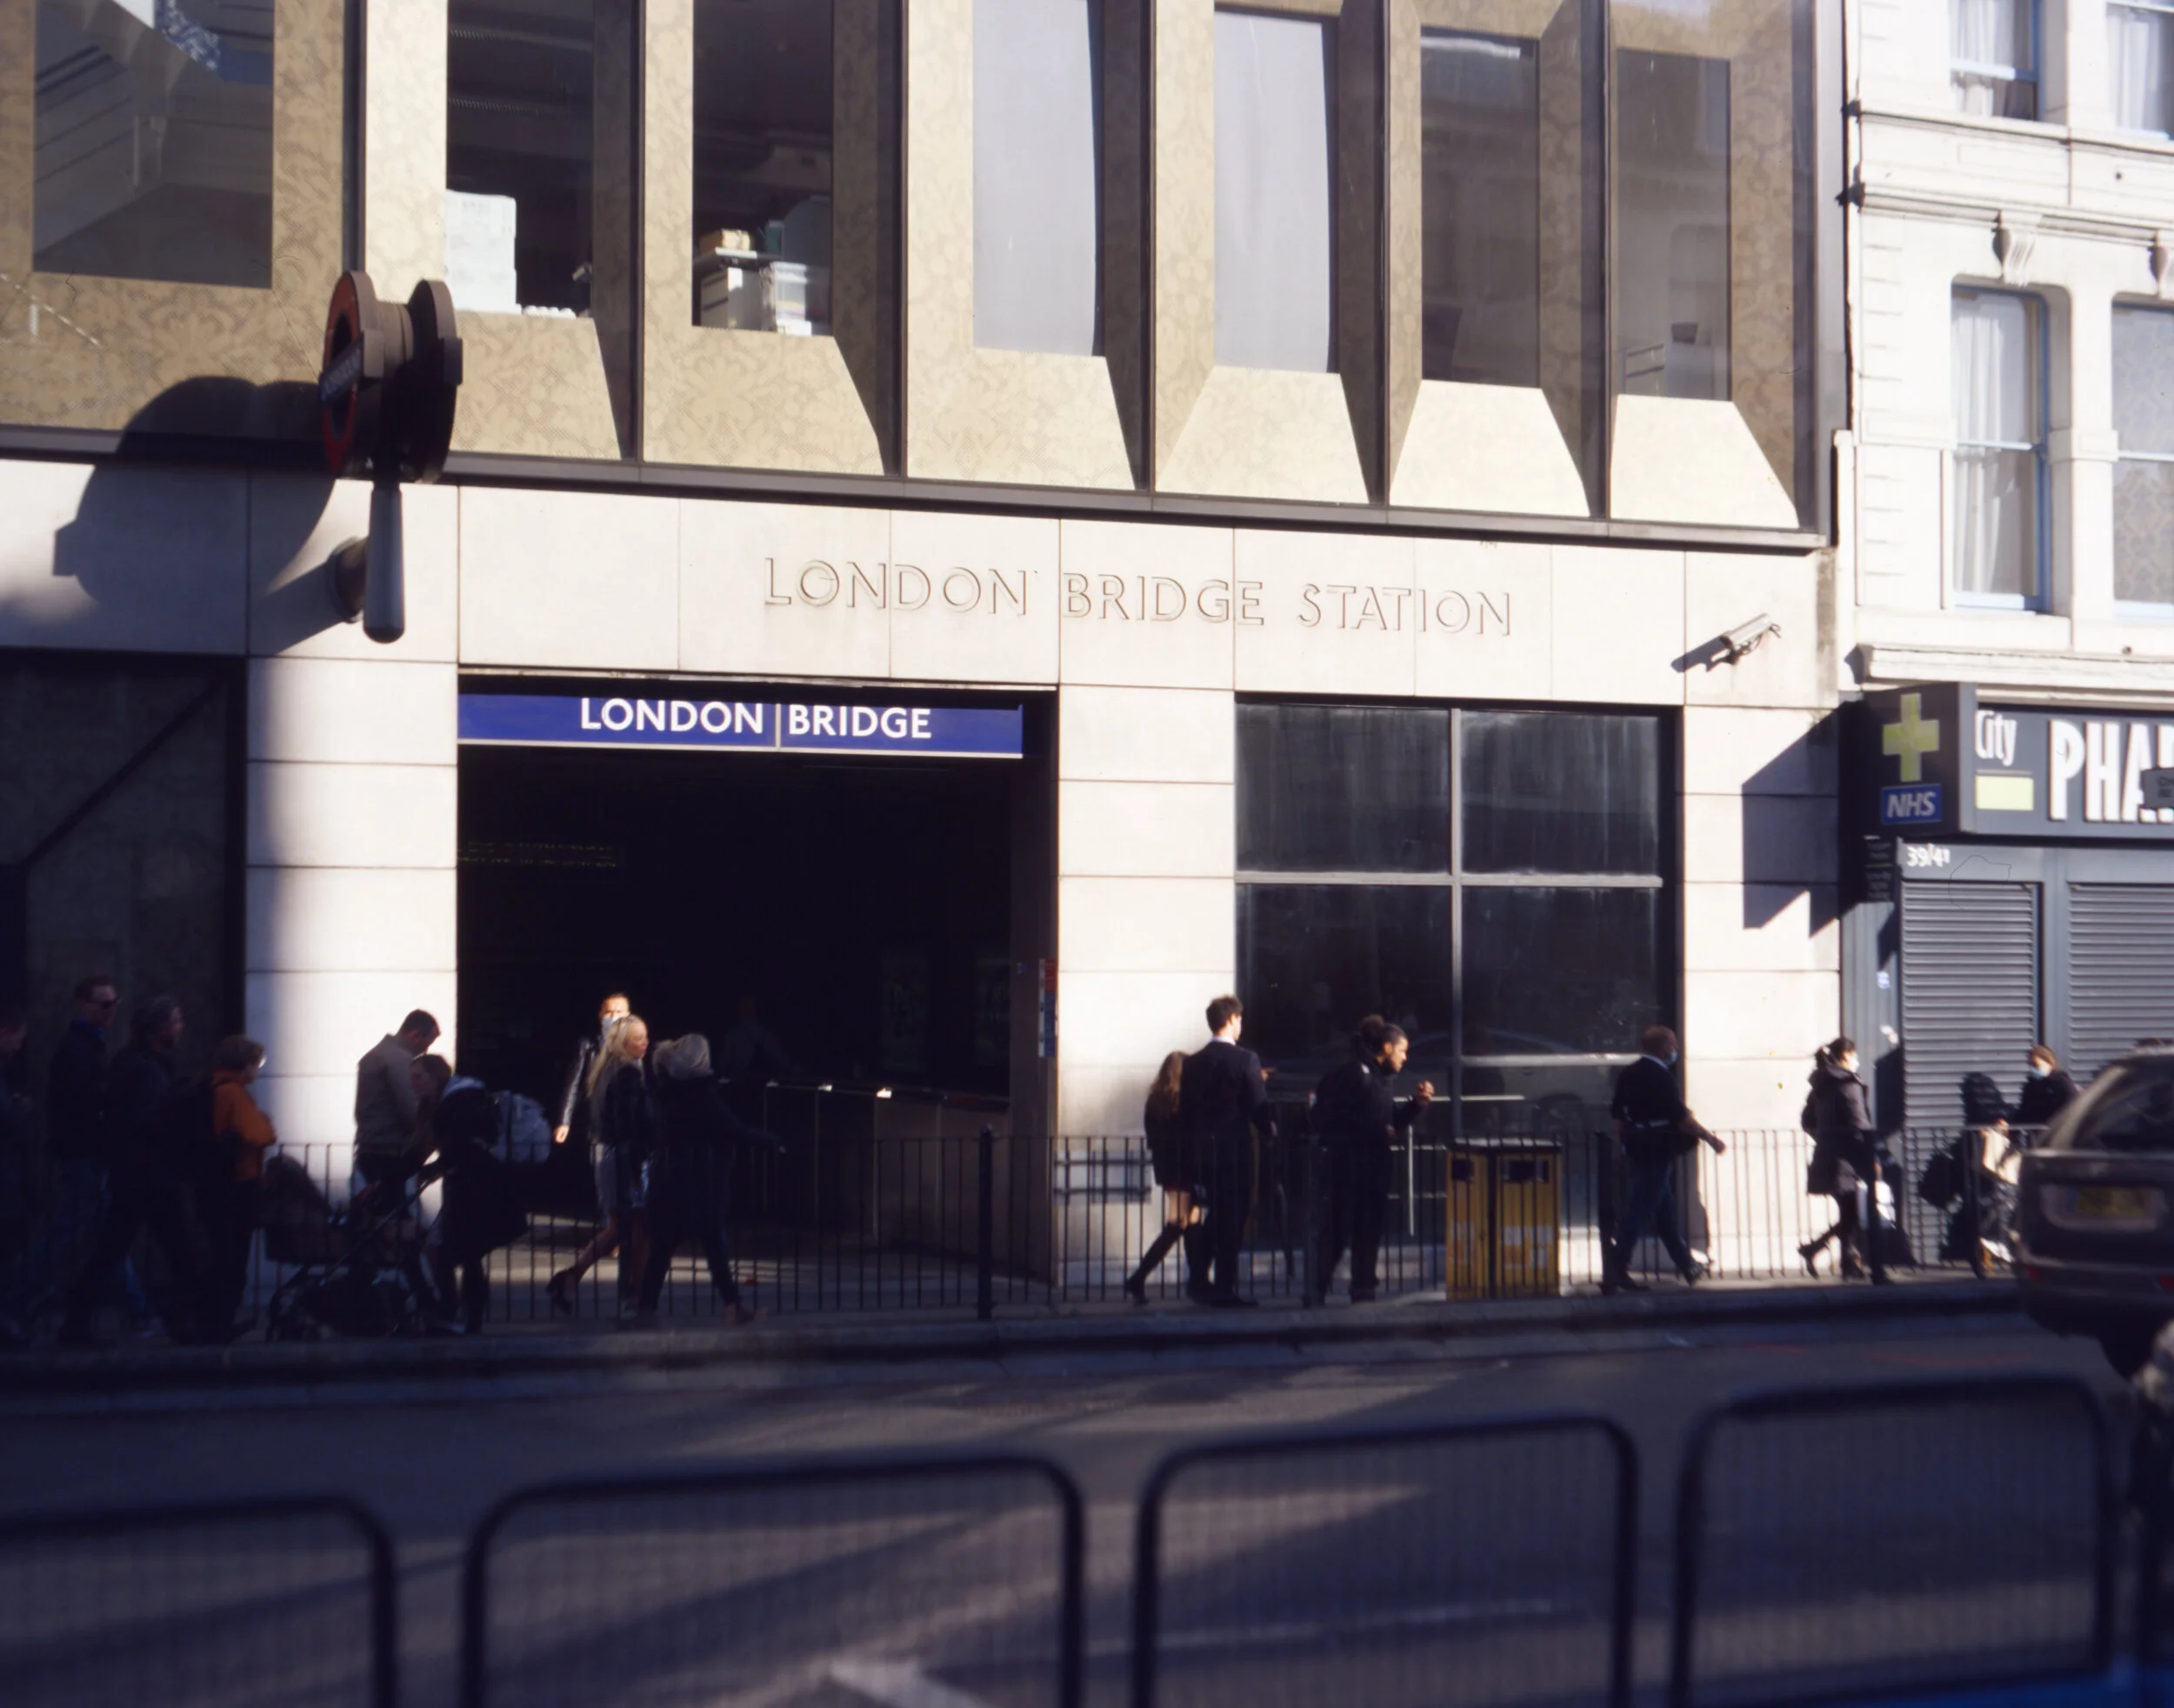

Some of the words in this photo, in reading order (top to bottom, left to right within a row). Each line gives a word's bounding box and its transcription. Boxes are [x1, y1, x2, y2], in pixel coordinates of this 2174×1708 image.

[765, 557, 1026, 616] LONDON
[1063, 572, 1264, 625] BRIDGE
[1297, 583, 1510, 636] STATION
[582, 697, 764, 734] LONDON
[789, 704, 931, 738] BRIDGE
[1975, 710, 2017, 766] City
[1887, 791, 1936, 818] NHS
[1906, 843, 1951, 867] 39/41
